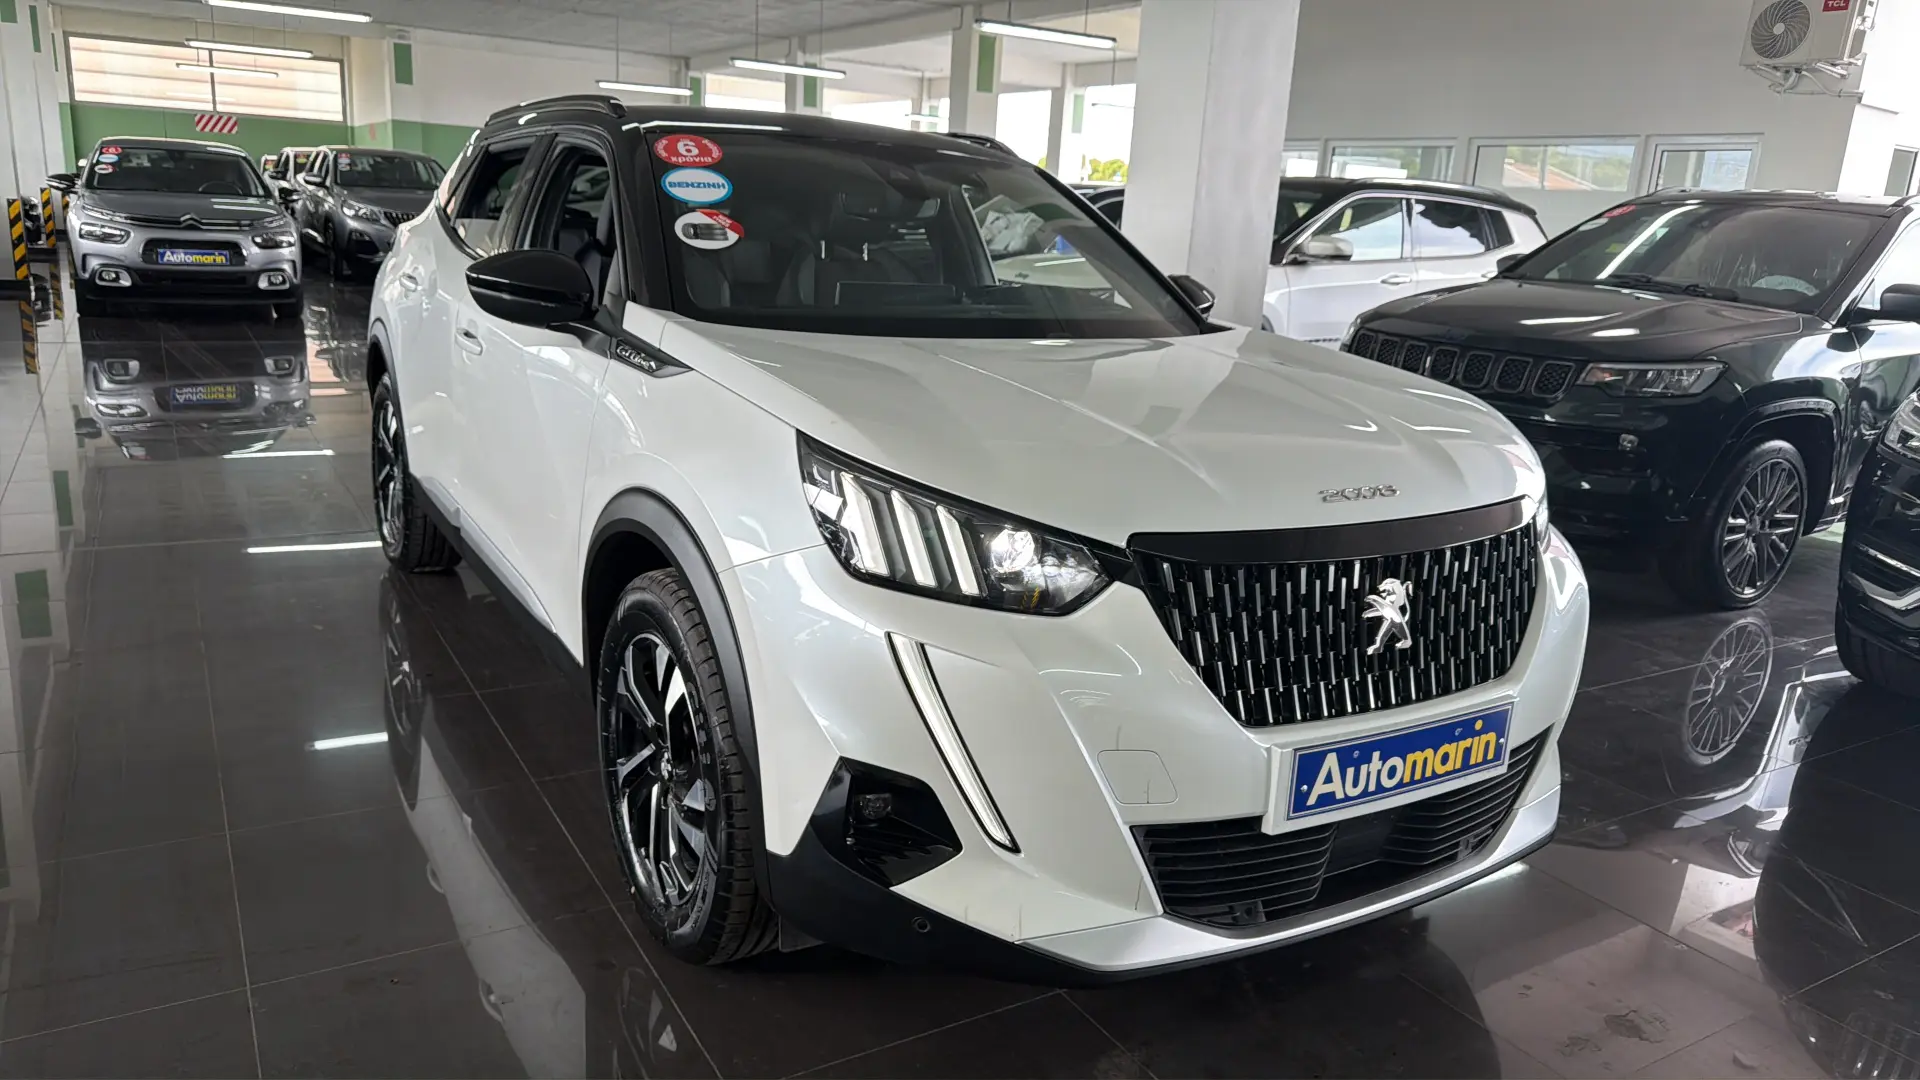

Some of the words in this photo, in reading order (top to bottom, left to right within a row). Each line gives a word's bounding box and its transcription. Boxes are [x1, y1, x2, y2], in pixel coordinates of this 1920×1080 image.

[677, 141, 699, 156] 6
[667, 181, 726, 190] ΒΕΝΖΙΝΗ
[163, 250, 226, 263] Automarin
[1306, 719, 1497, 806] Automarin
